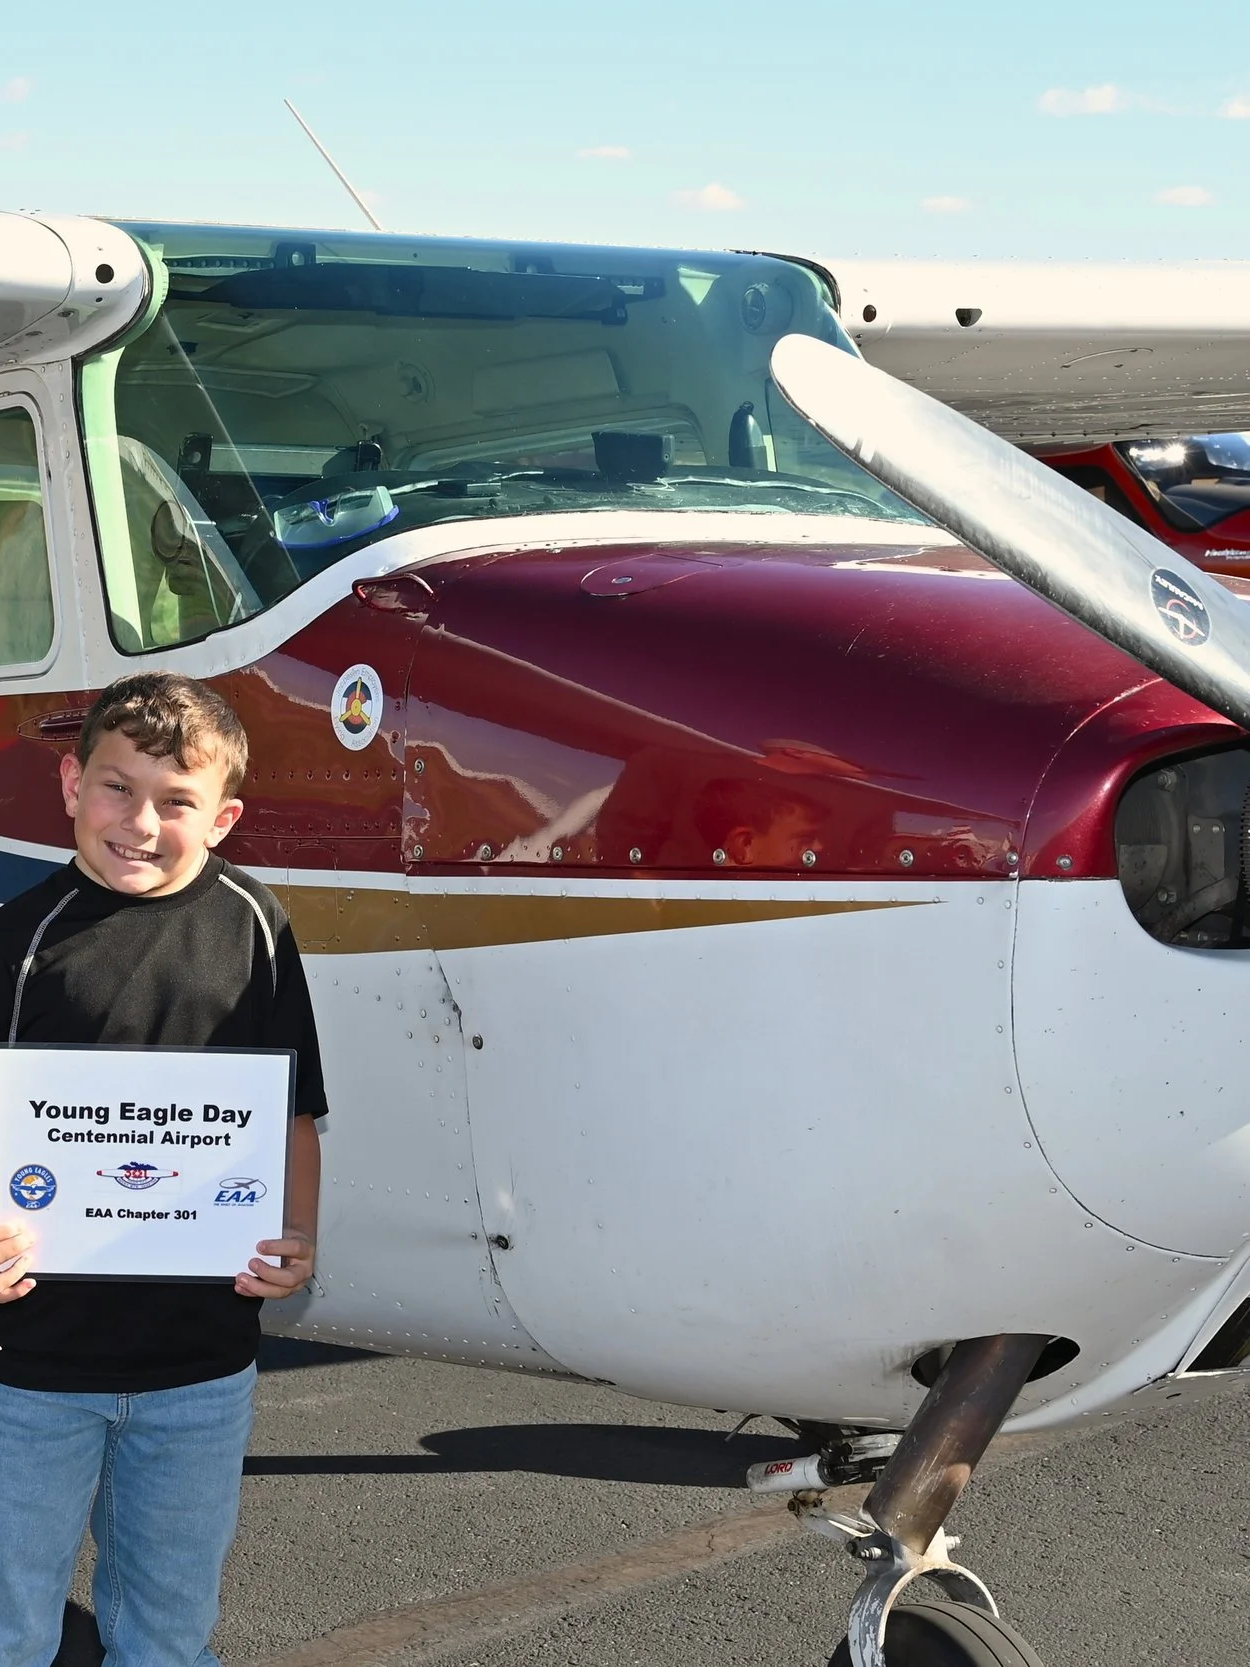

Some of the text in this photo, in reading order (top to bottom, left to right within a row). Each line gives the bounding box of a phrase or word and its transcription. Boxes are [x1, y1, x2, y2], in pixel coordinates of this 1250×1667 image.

[29, 1100, 252, 1128] Young Eagle Day
[47, 1128, 231, 1148] Centennial Airport
[14, 1167, 53, 1183] YOUNG EAGLES
[214, 1190, 256, 1202] EAA
[85, 1208, 197, 1221] EAA Chapter 301
[764, 1462, 793, 1475] LORD
